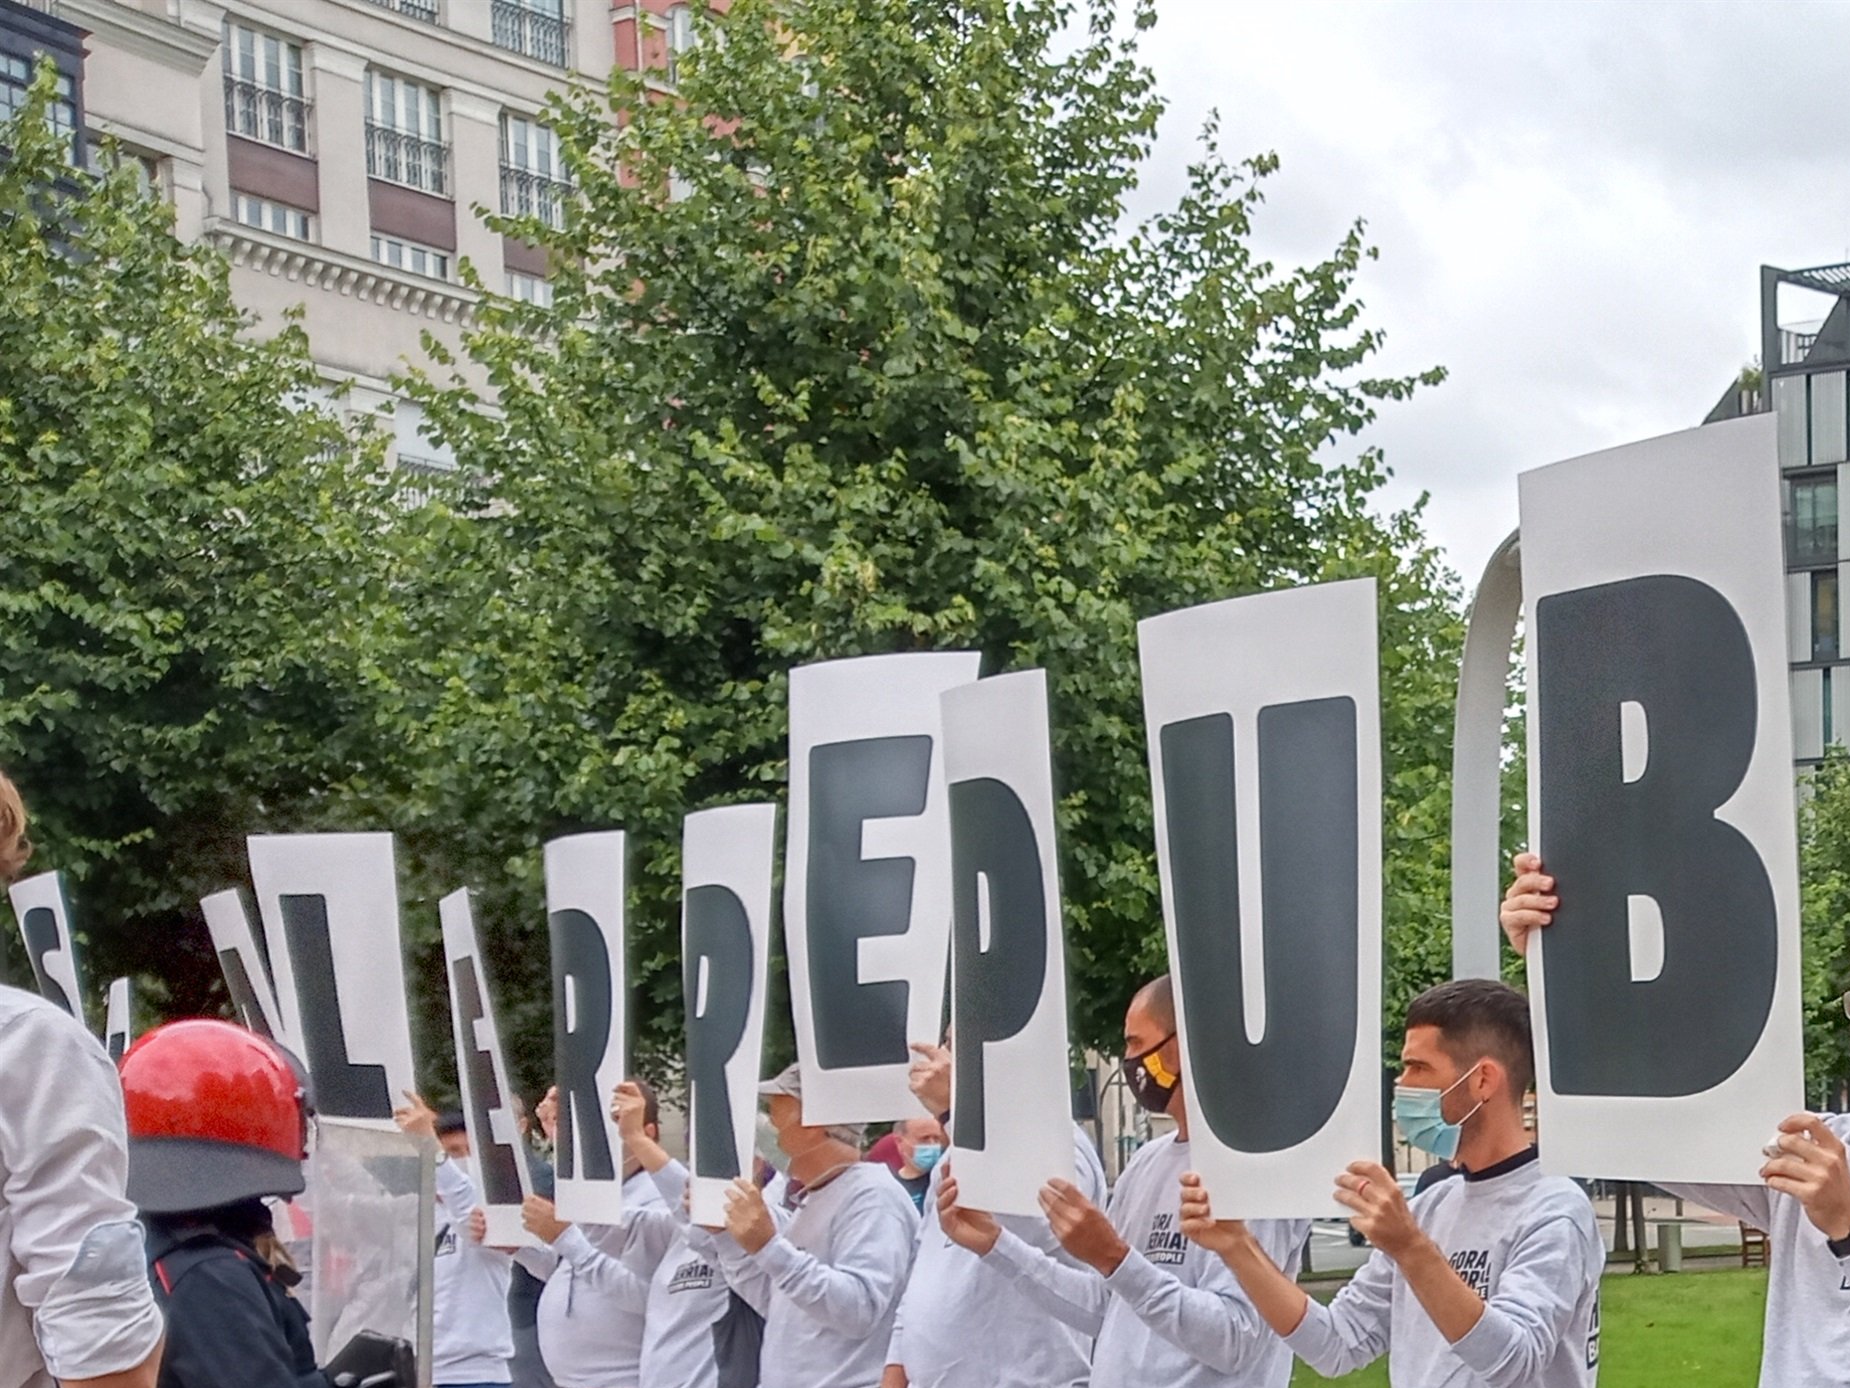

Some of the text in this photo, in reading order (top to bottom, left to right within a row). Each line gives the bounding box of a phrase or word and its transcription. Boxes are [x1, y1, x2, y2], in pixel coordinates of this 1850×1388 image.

[279, 893, 394, 1119] L
[806, 734, 933, 1070] E
[948, 776, 1047, 1151] P
[1160, 695, 1358, 1154] U
[1537, 574, 1779, 1098] B
